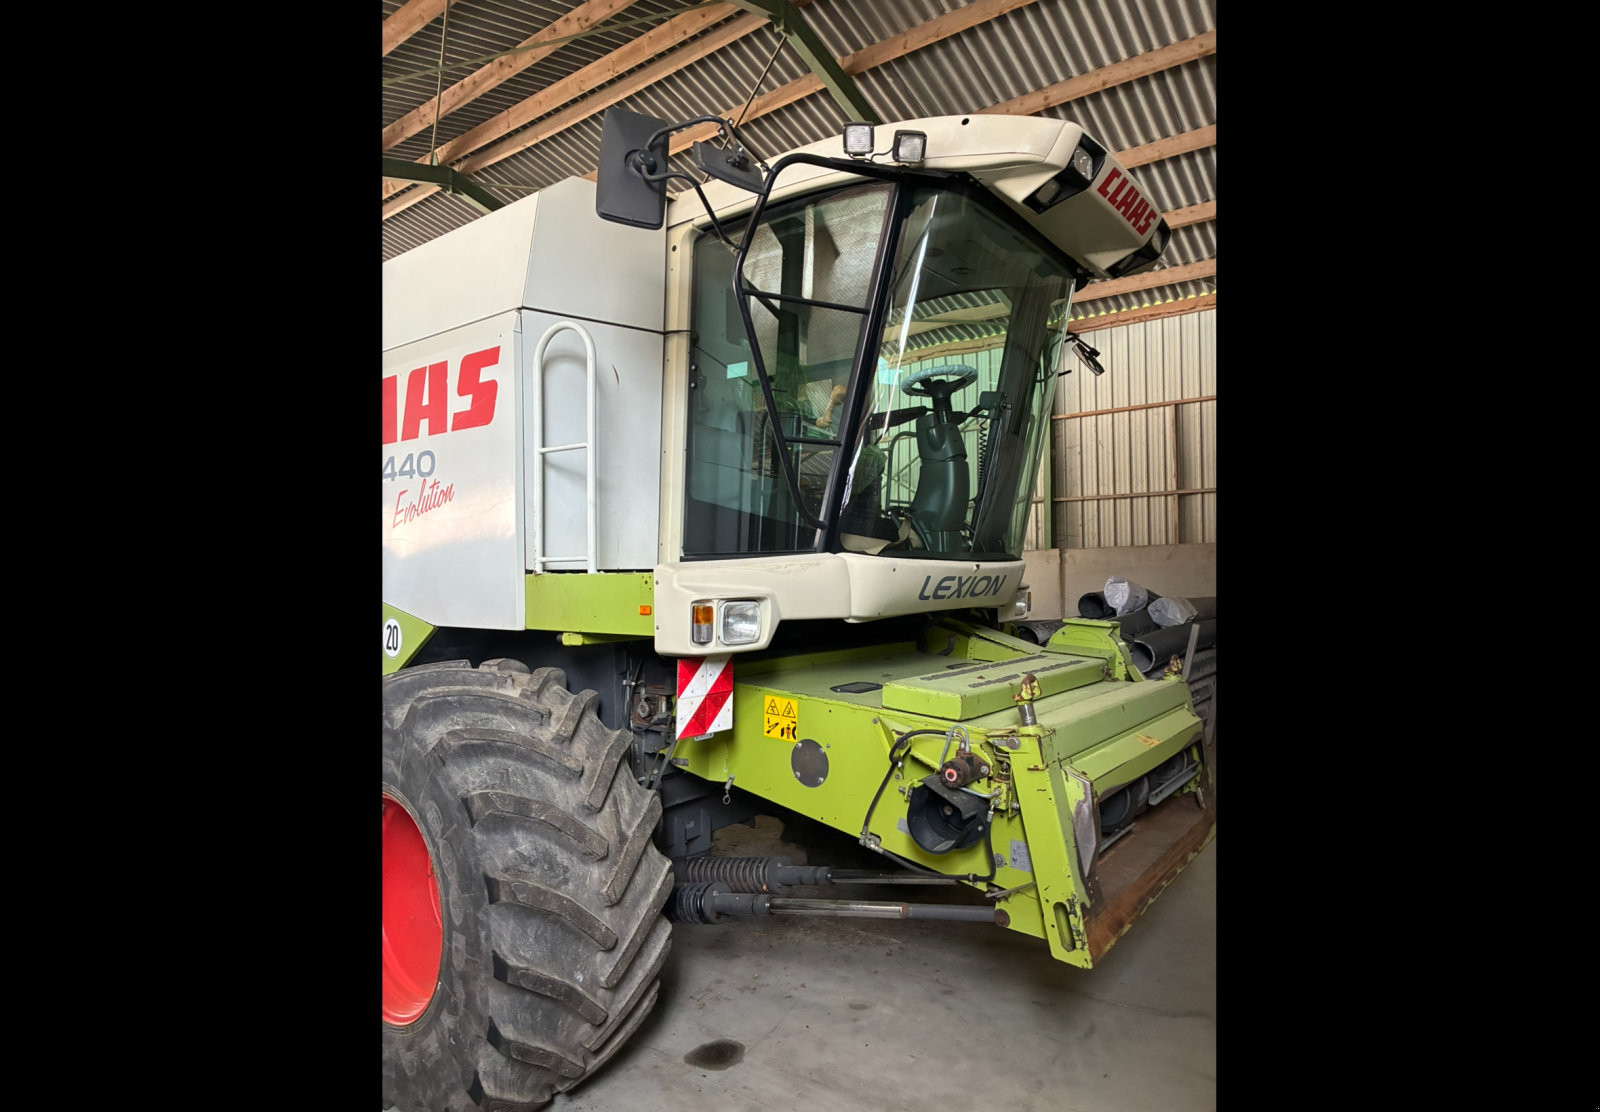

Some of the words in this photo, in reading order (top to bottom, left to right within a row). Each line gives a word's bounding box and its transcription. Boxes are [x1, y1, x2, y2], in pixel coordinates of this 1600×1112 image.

[1097, 167, 1157, 236] CLAAS
[382, 450, 436, 482] 440
[392, 478, 455, 529] Evolution
[918, 575, 1007, 601] LEXION
[386, 624, 399, 651] 20
